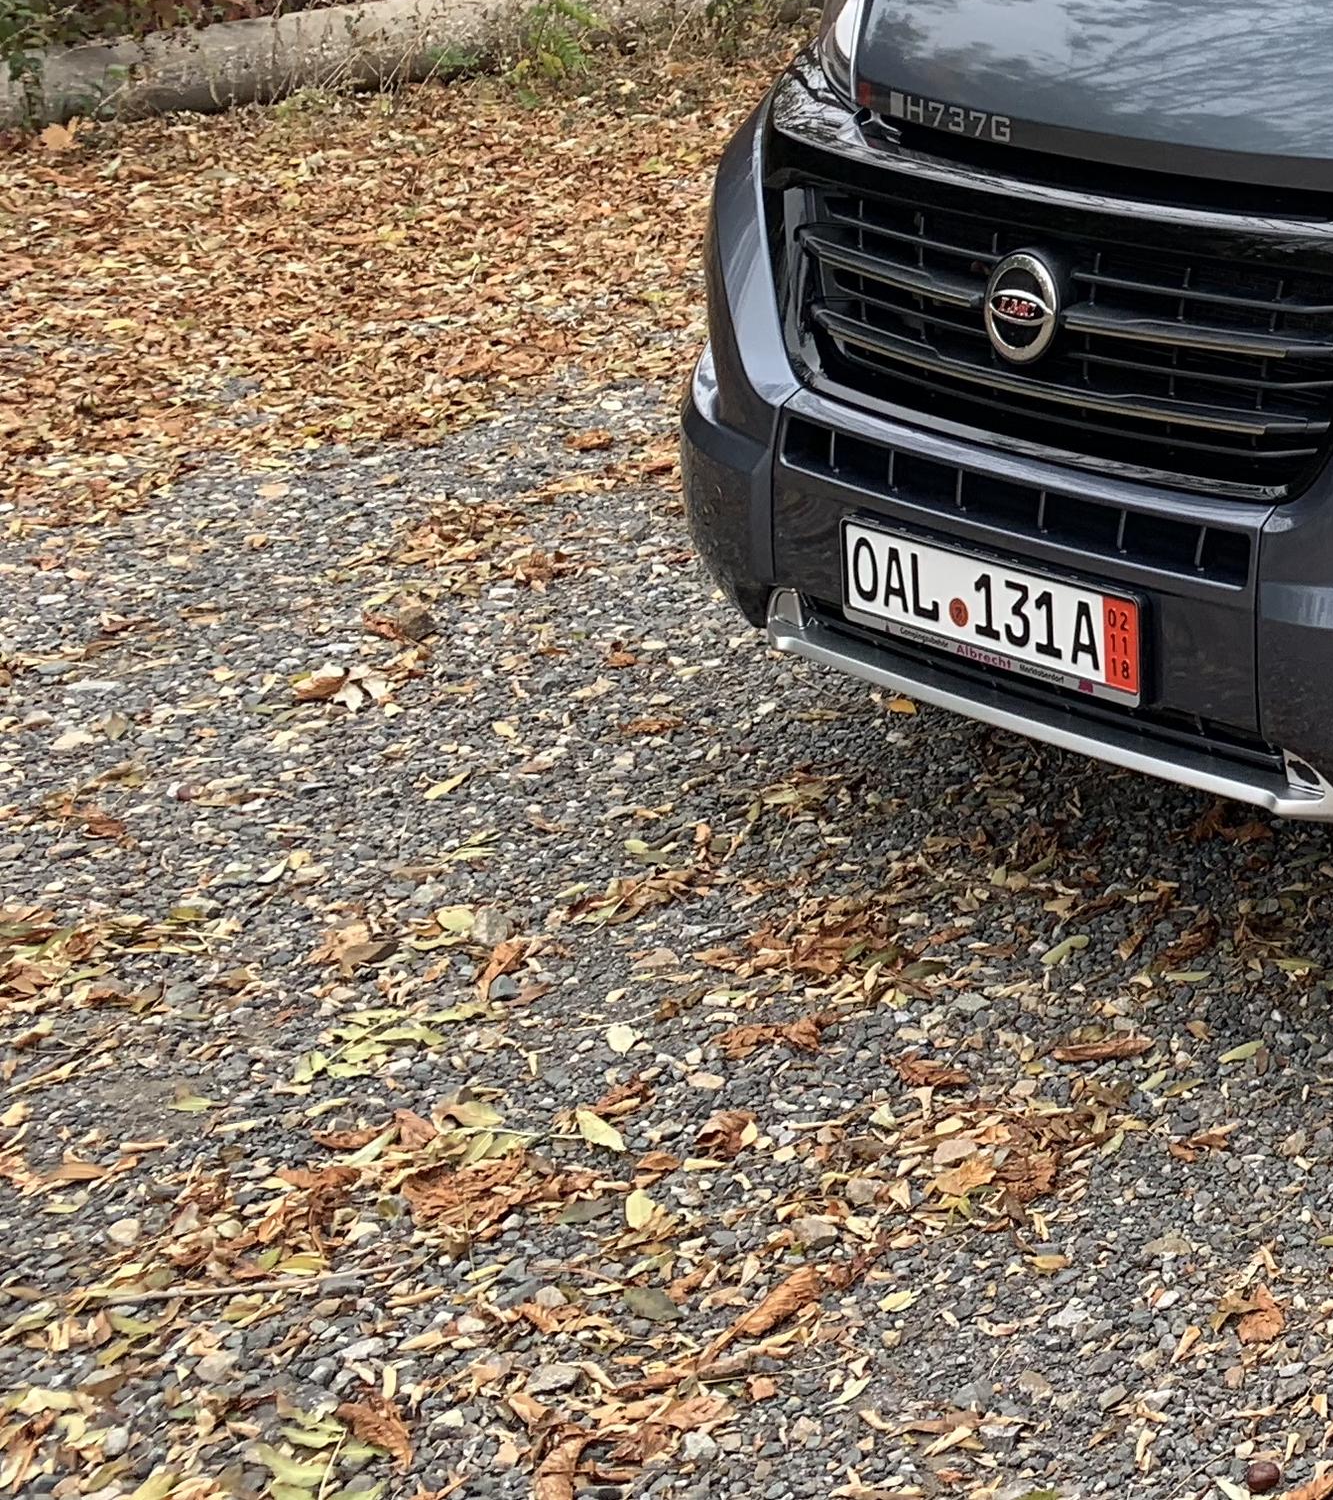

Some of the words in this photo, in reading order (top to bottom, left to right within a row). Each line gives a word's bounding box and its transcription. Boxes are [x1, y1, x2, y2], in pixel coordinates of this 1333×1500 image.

[906, 95, 1011, 143] H737G
[852, 536, 940, 622] OAL
[973, 573, 1100, 671] 131A
[1107, 608, 1129, 632] 02
[955, 643, 1012, 671] Albrecht
[1110, 633, 1128, 656] 11
[1111, 657, 1130, 680] 18
